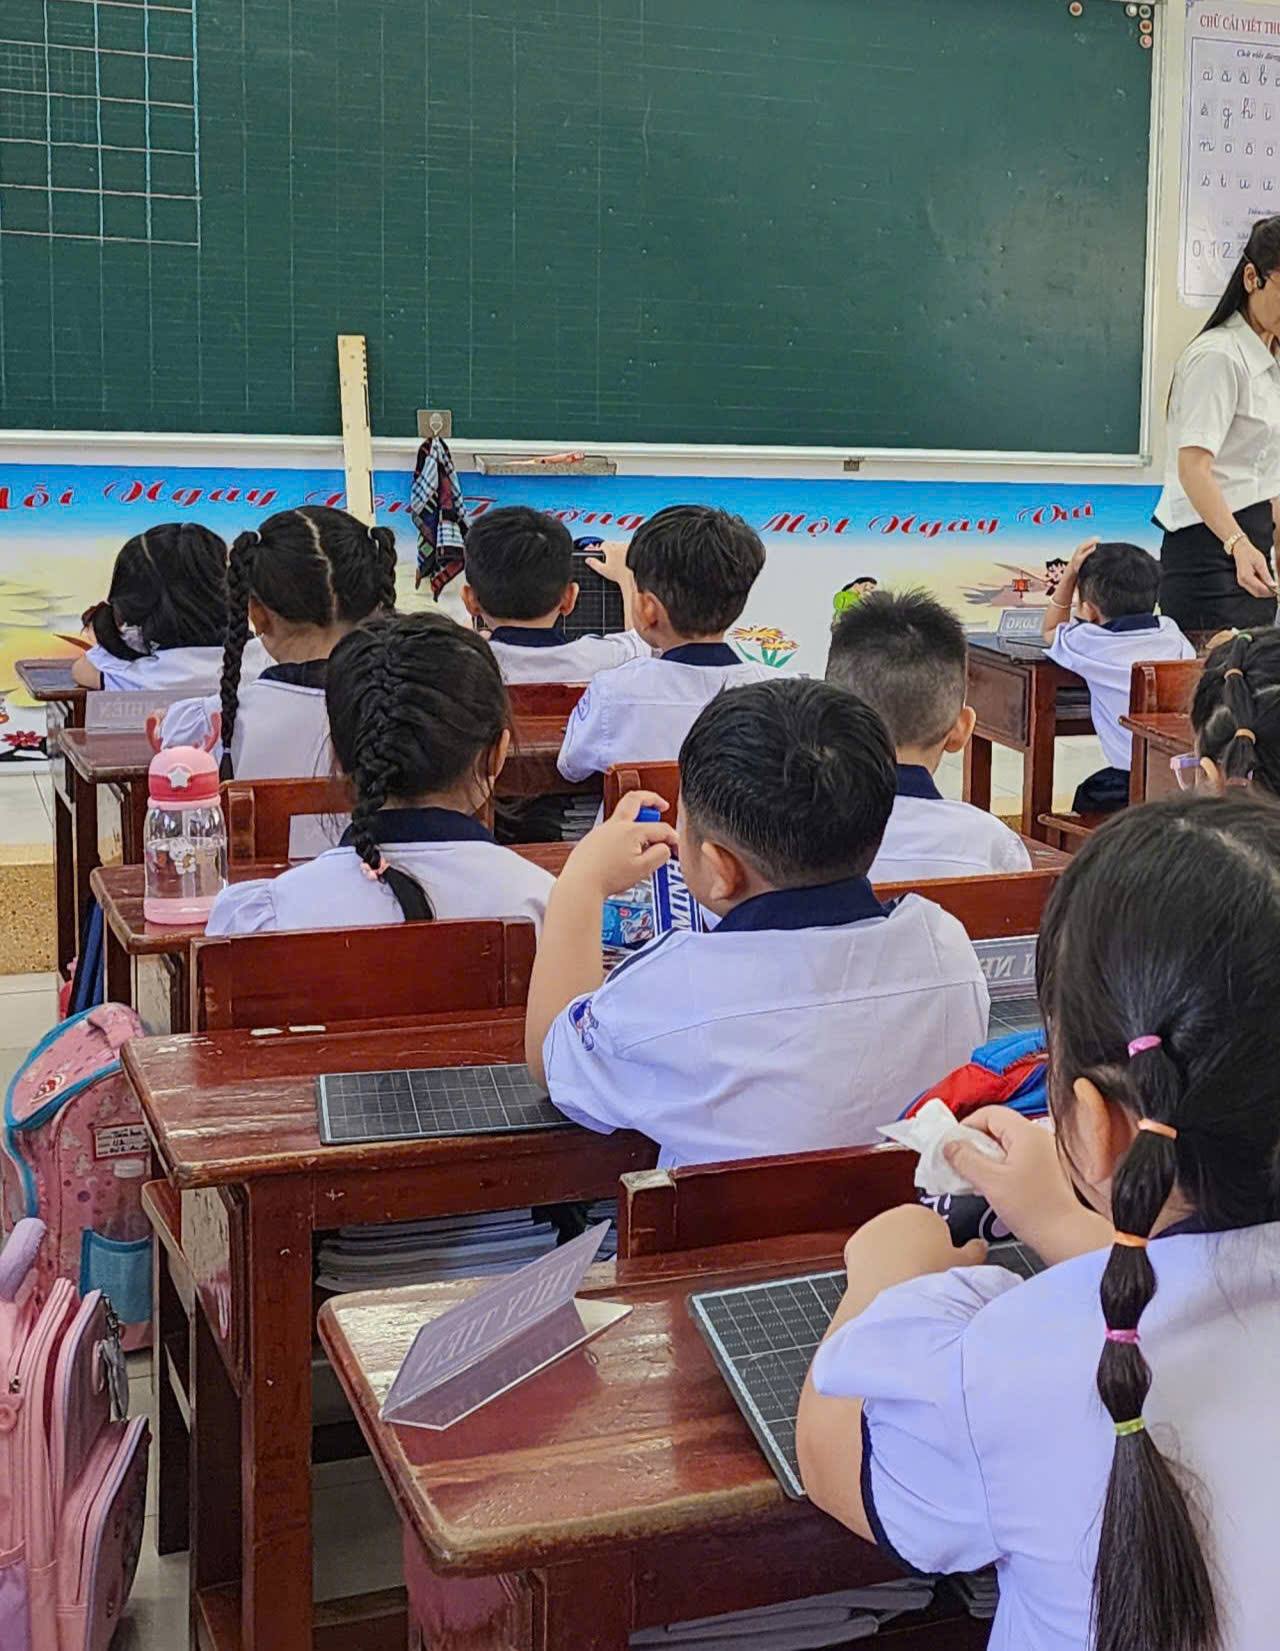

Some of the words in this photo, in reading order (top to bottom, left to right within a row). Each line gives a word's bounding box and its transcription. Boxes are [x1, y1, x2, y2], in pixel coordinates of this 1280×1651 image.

[1222, 13, 1239, 31] CÁI
[1241, 16, 1261, 33] VIẾT
[1222, 242, 1231, 258] 2
[760, 511, 849, 538] Một
